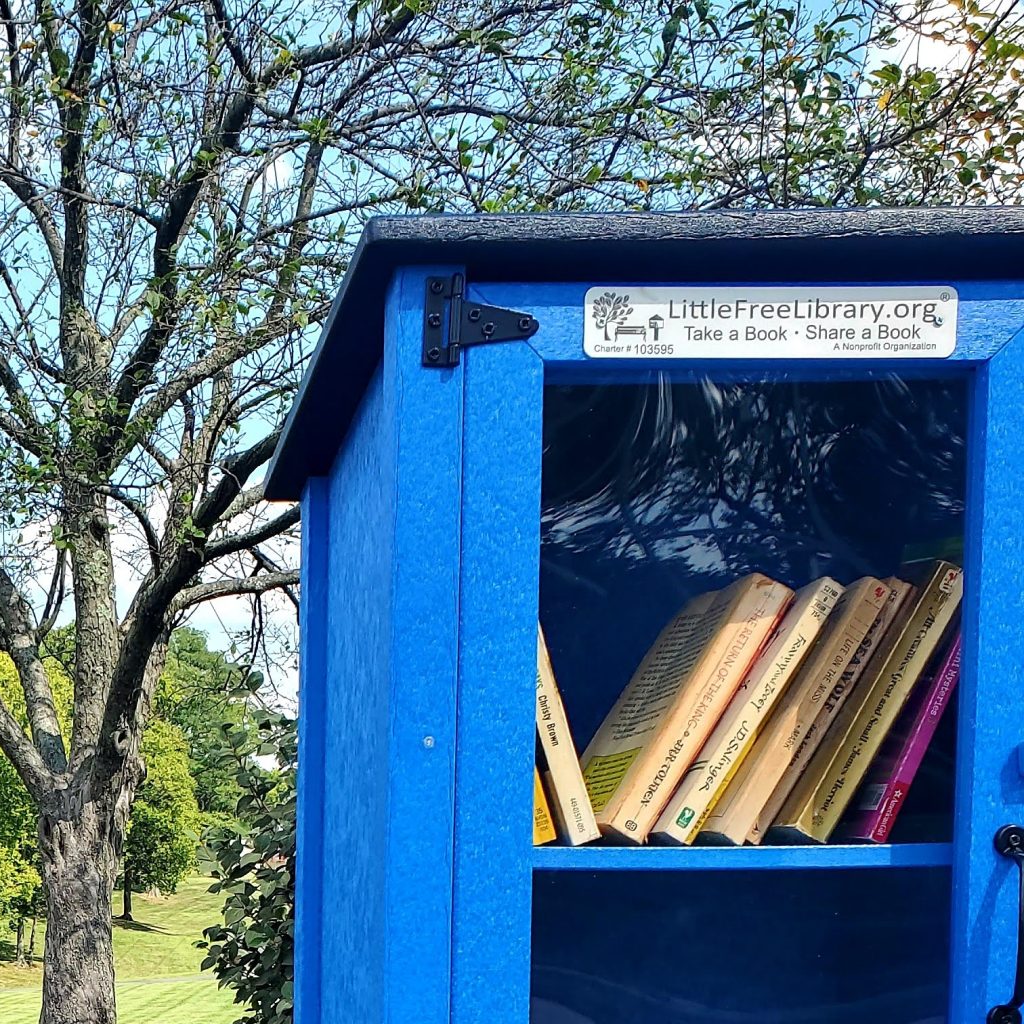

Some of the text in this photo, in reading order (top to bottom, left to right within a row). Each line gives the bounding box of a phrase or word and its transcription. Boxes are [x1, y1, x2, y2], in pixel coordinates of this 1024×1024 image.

[669, 298, 938, 323] LittleFreeLibrary.org
[684, 323, 921, 341] Take a Book Share a Book
[594, 343, 674, 355] Charter # 103595
[833, 342, 937, 352] A Nonprofit Organization
[725, 627, 753, 668] RETURN
[842, 638, 854, 657] LIFE
[831, 655, 844, 667] ON
[826, 666, 836, 684] THE
[930, 669, 958, 717] Mysteries
[537, 694, 552, 721] Christy
[546, 722, 559, 747] Brown
[688, 702, 711, 729] KING
